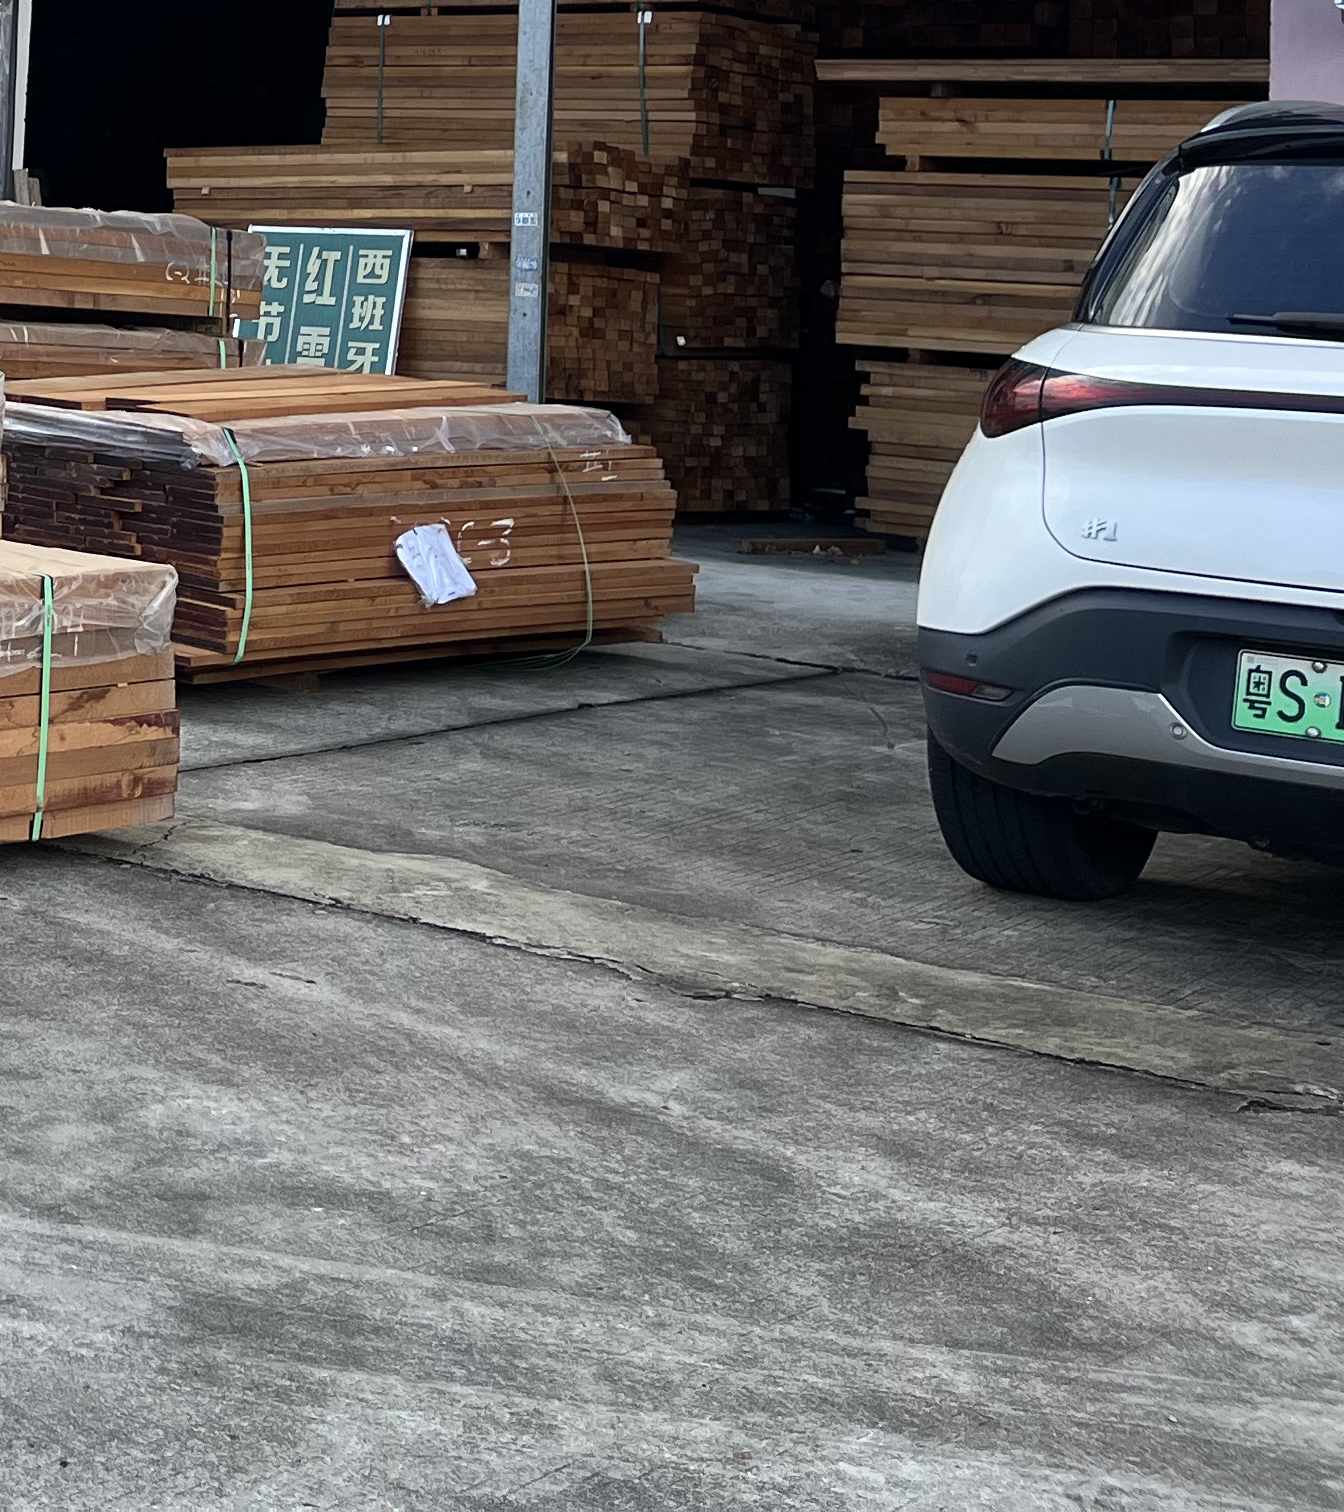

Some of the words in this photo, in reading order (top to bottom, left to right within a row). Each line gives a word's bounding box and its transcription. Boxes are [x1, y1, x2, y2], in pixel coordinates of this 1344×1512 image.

[251, 245, 291, 366] 无节
[347, 249, 394, 374] 西班牙
[1242, 665, 1344, 730] 粤S
